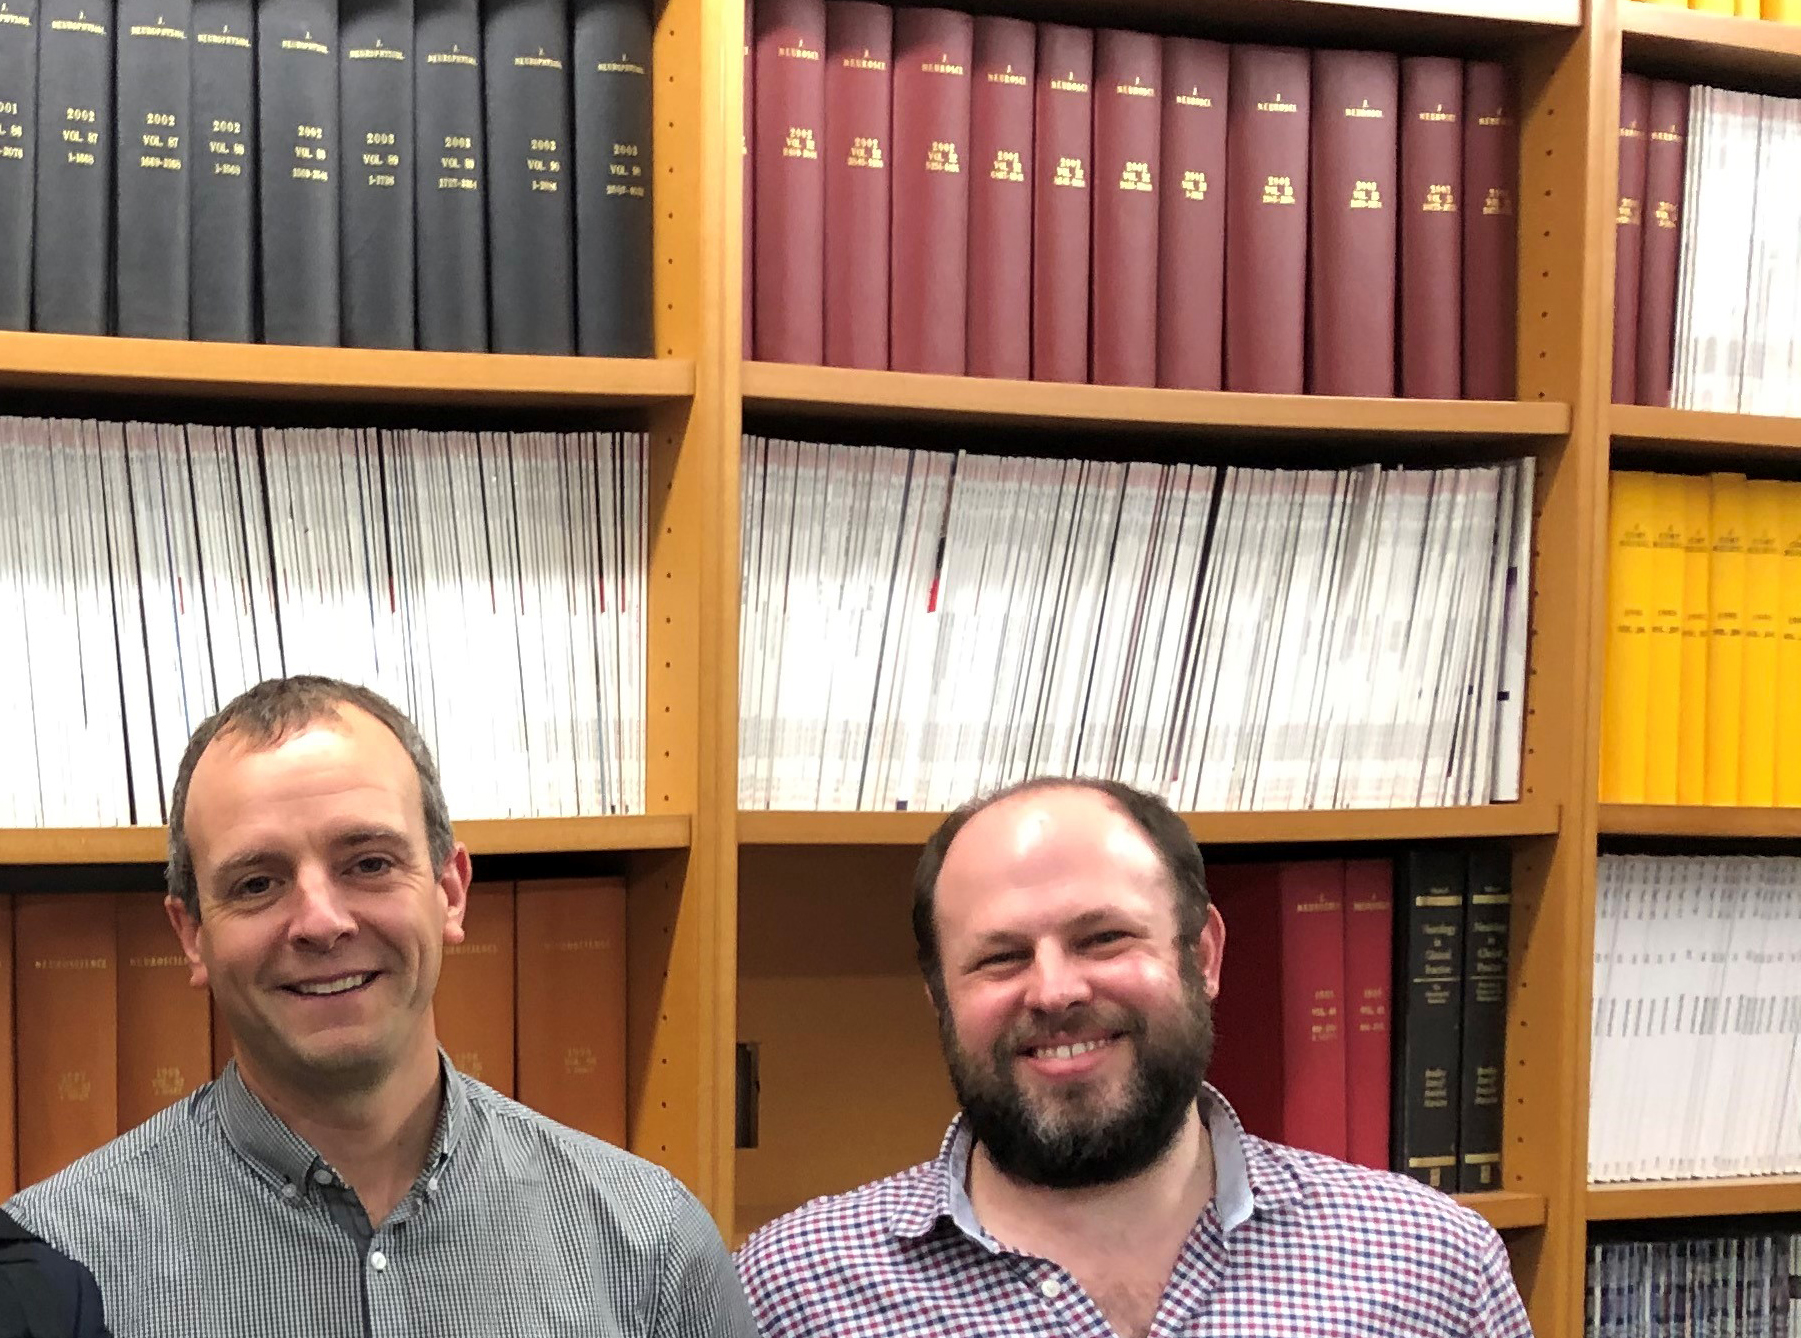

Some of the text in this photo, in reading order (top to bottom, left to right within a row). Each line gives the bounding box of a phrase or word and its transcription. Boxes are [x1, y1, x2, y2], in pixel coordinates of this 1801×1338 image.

[66, 107, 95, 122] 2002
[146, 112, 175, 127] 2002
[213, 120, 241, 134] 2002
[298, 125, 323, 139] 2002
